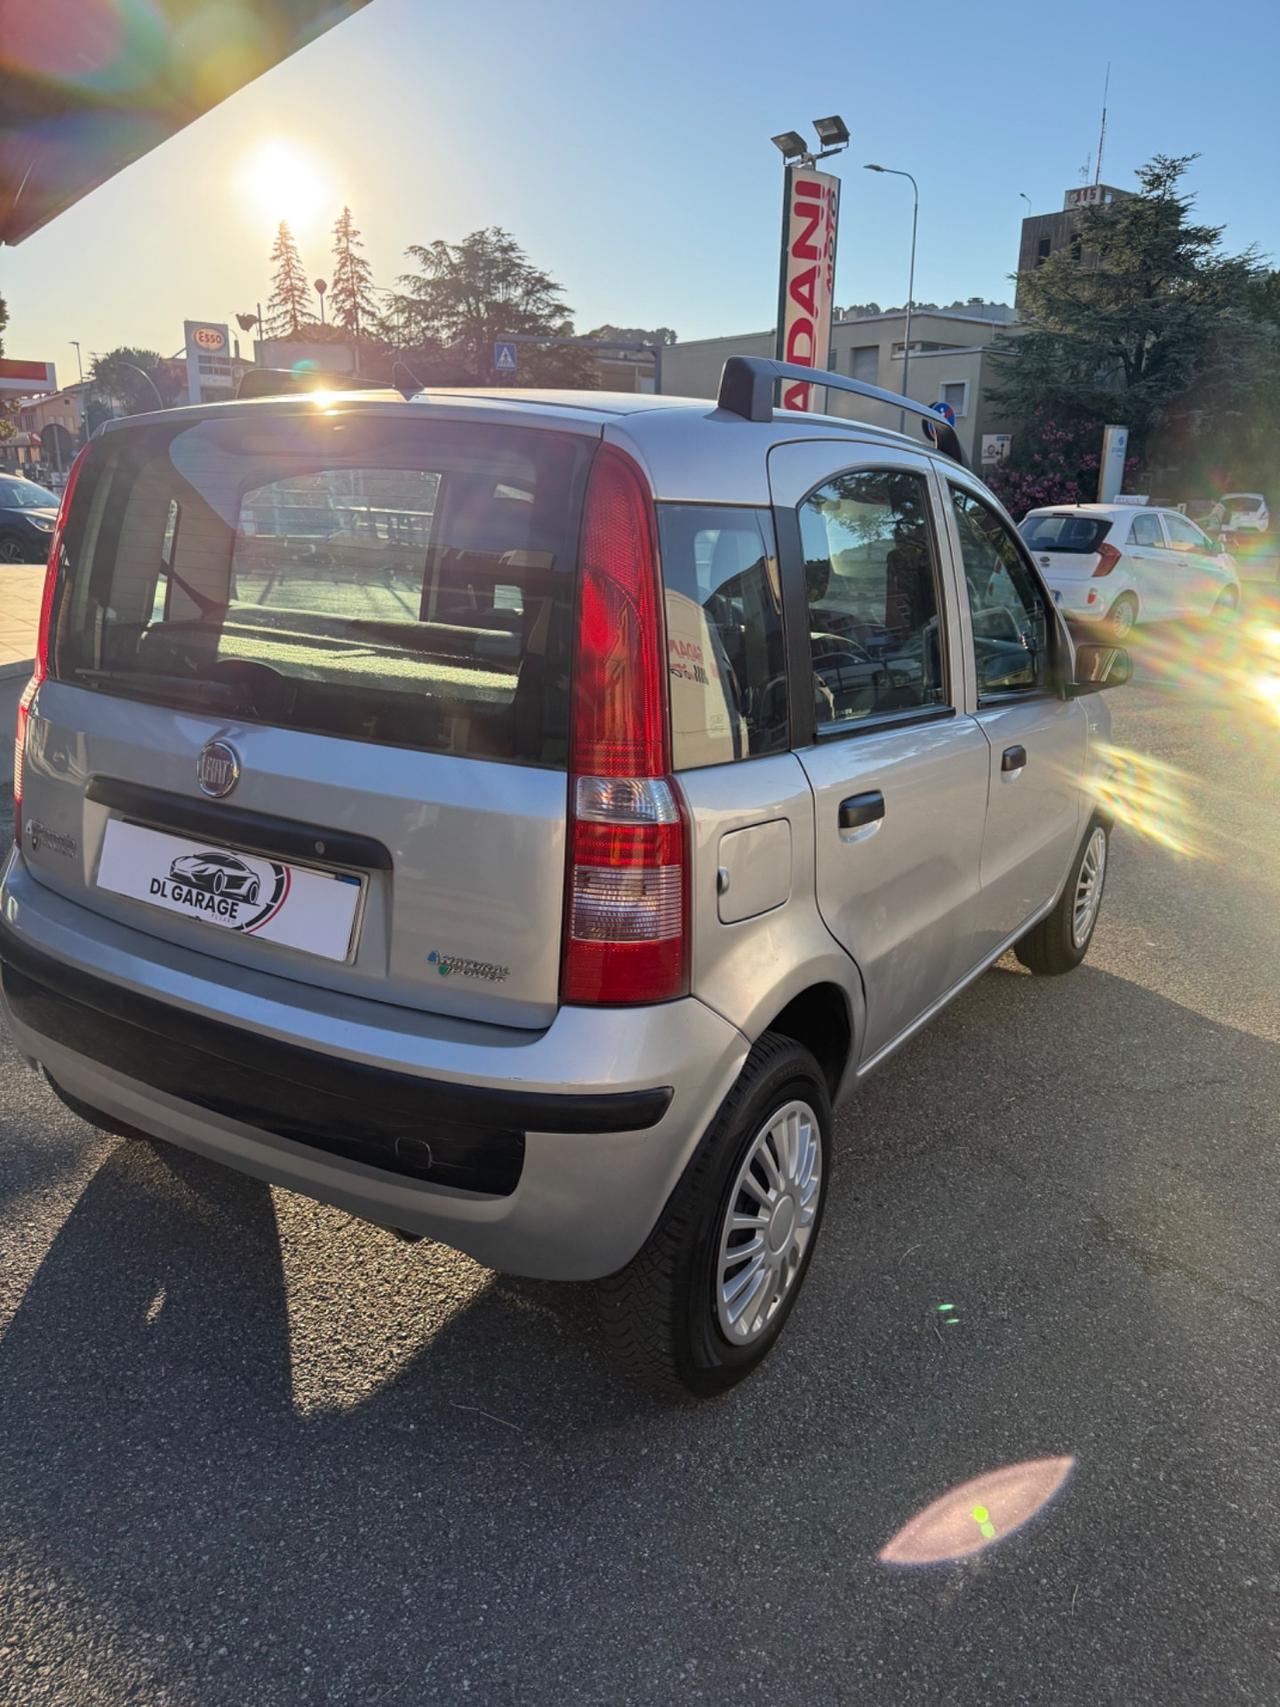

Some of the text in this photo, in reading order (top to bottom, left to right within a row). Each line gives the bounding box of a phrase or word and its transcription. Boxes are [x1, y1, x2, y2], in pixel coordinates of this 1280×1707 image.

[204, 757, 231, 784] FIAT
[149, 877, 240, 920] DL GARAGE
